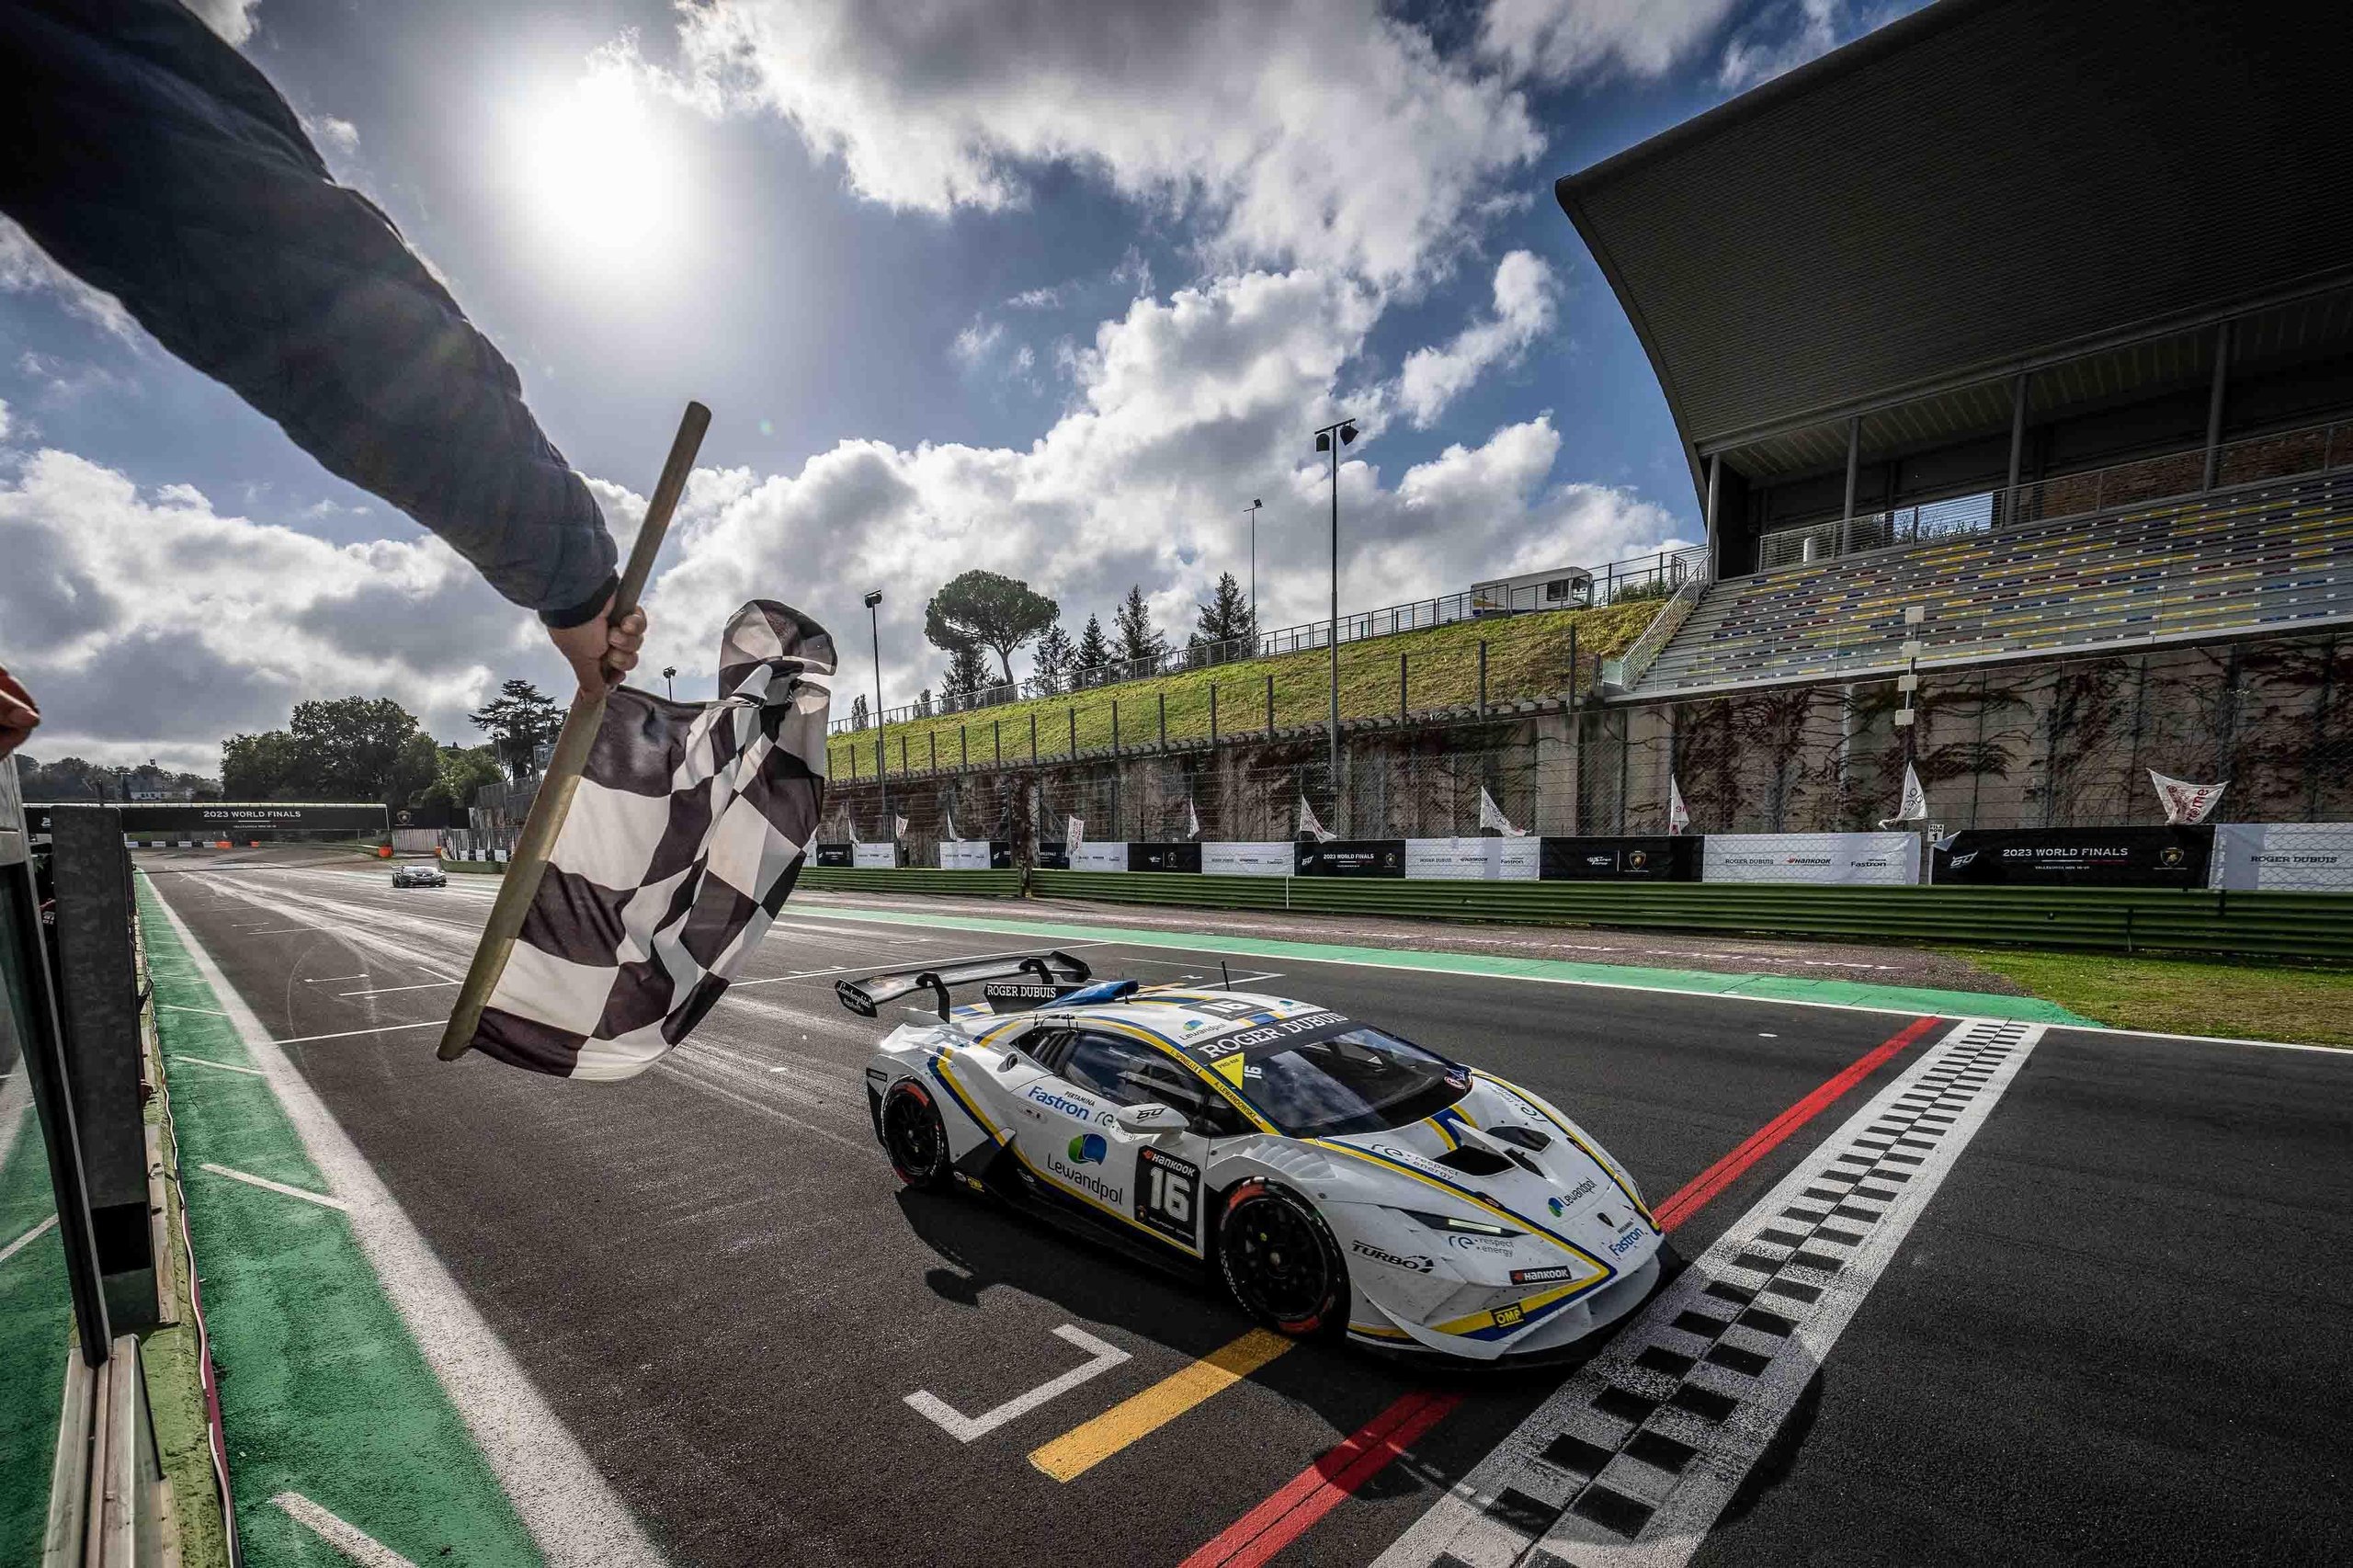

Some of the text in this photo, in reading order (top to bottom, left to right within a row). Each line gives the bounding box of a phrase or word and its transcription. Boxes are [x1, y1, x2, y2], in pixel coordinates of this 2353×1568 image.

[1932, 832, 1938, 841] 1
[2003, 847, 2129, 857] 2023 WORLD FINALS
[987, 985, 1056, 998] ROGER DUBUIS
[1199, 1000, 1253, 1013] 16
[1178, 1023, 1227, 1041] Lewandpol
[1197, 1011, 1349, 1059] ROGER DUBUIS
[1217, 1058, 1239, 1070] PRO-AM
[1244, 1065, 1263, 1079] 16
[1029, 1085, 1090, 1121] Fastron
[1064, 1090, 1096, 1107] PERTAMINA
[1219, 1085, 1256, 1119] LEWANDOWSKI
[1412, 1161, 1454, 1180] energy
[1414, 1154, 1460, 1176] respect
[1047, 1153, 1123, 1206] Lewandpol
[1150, 1166, 1190, 1222] 16
[1558, 1176, 1597, 1207] Lewandpol
[1479, 1237, 1515, 1249] respect
[1608, 1227, 1643, 1256] Fastron
[1482, 1246, 1515, 1257] energy
[1496, 1309, 1521, 1325] OMP
